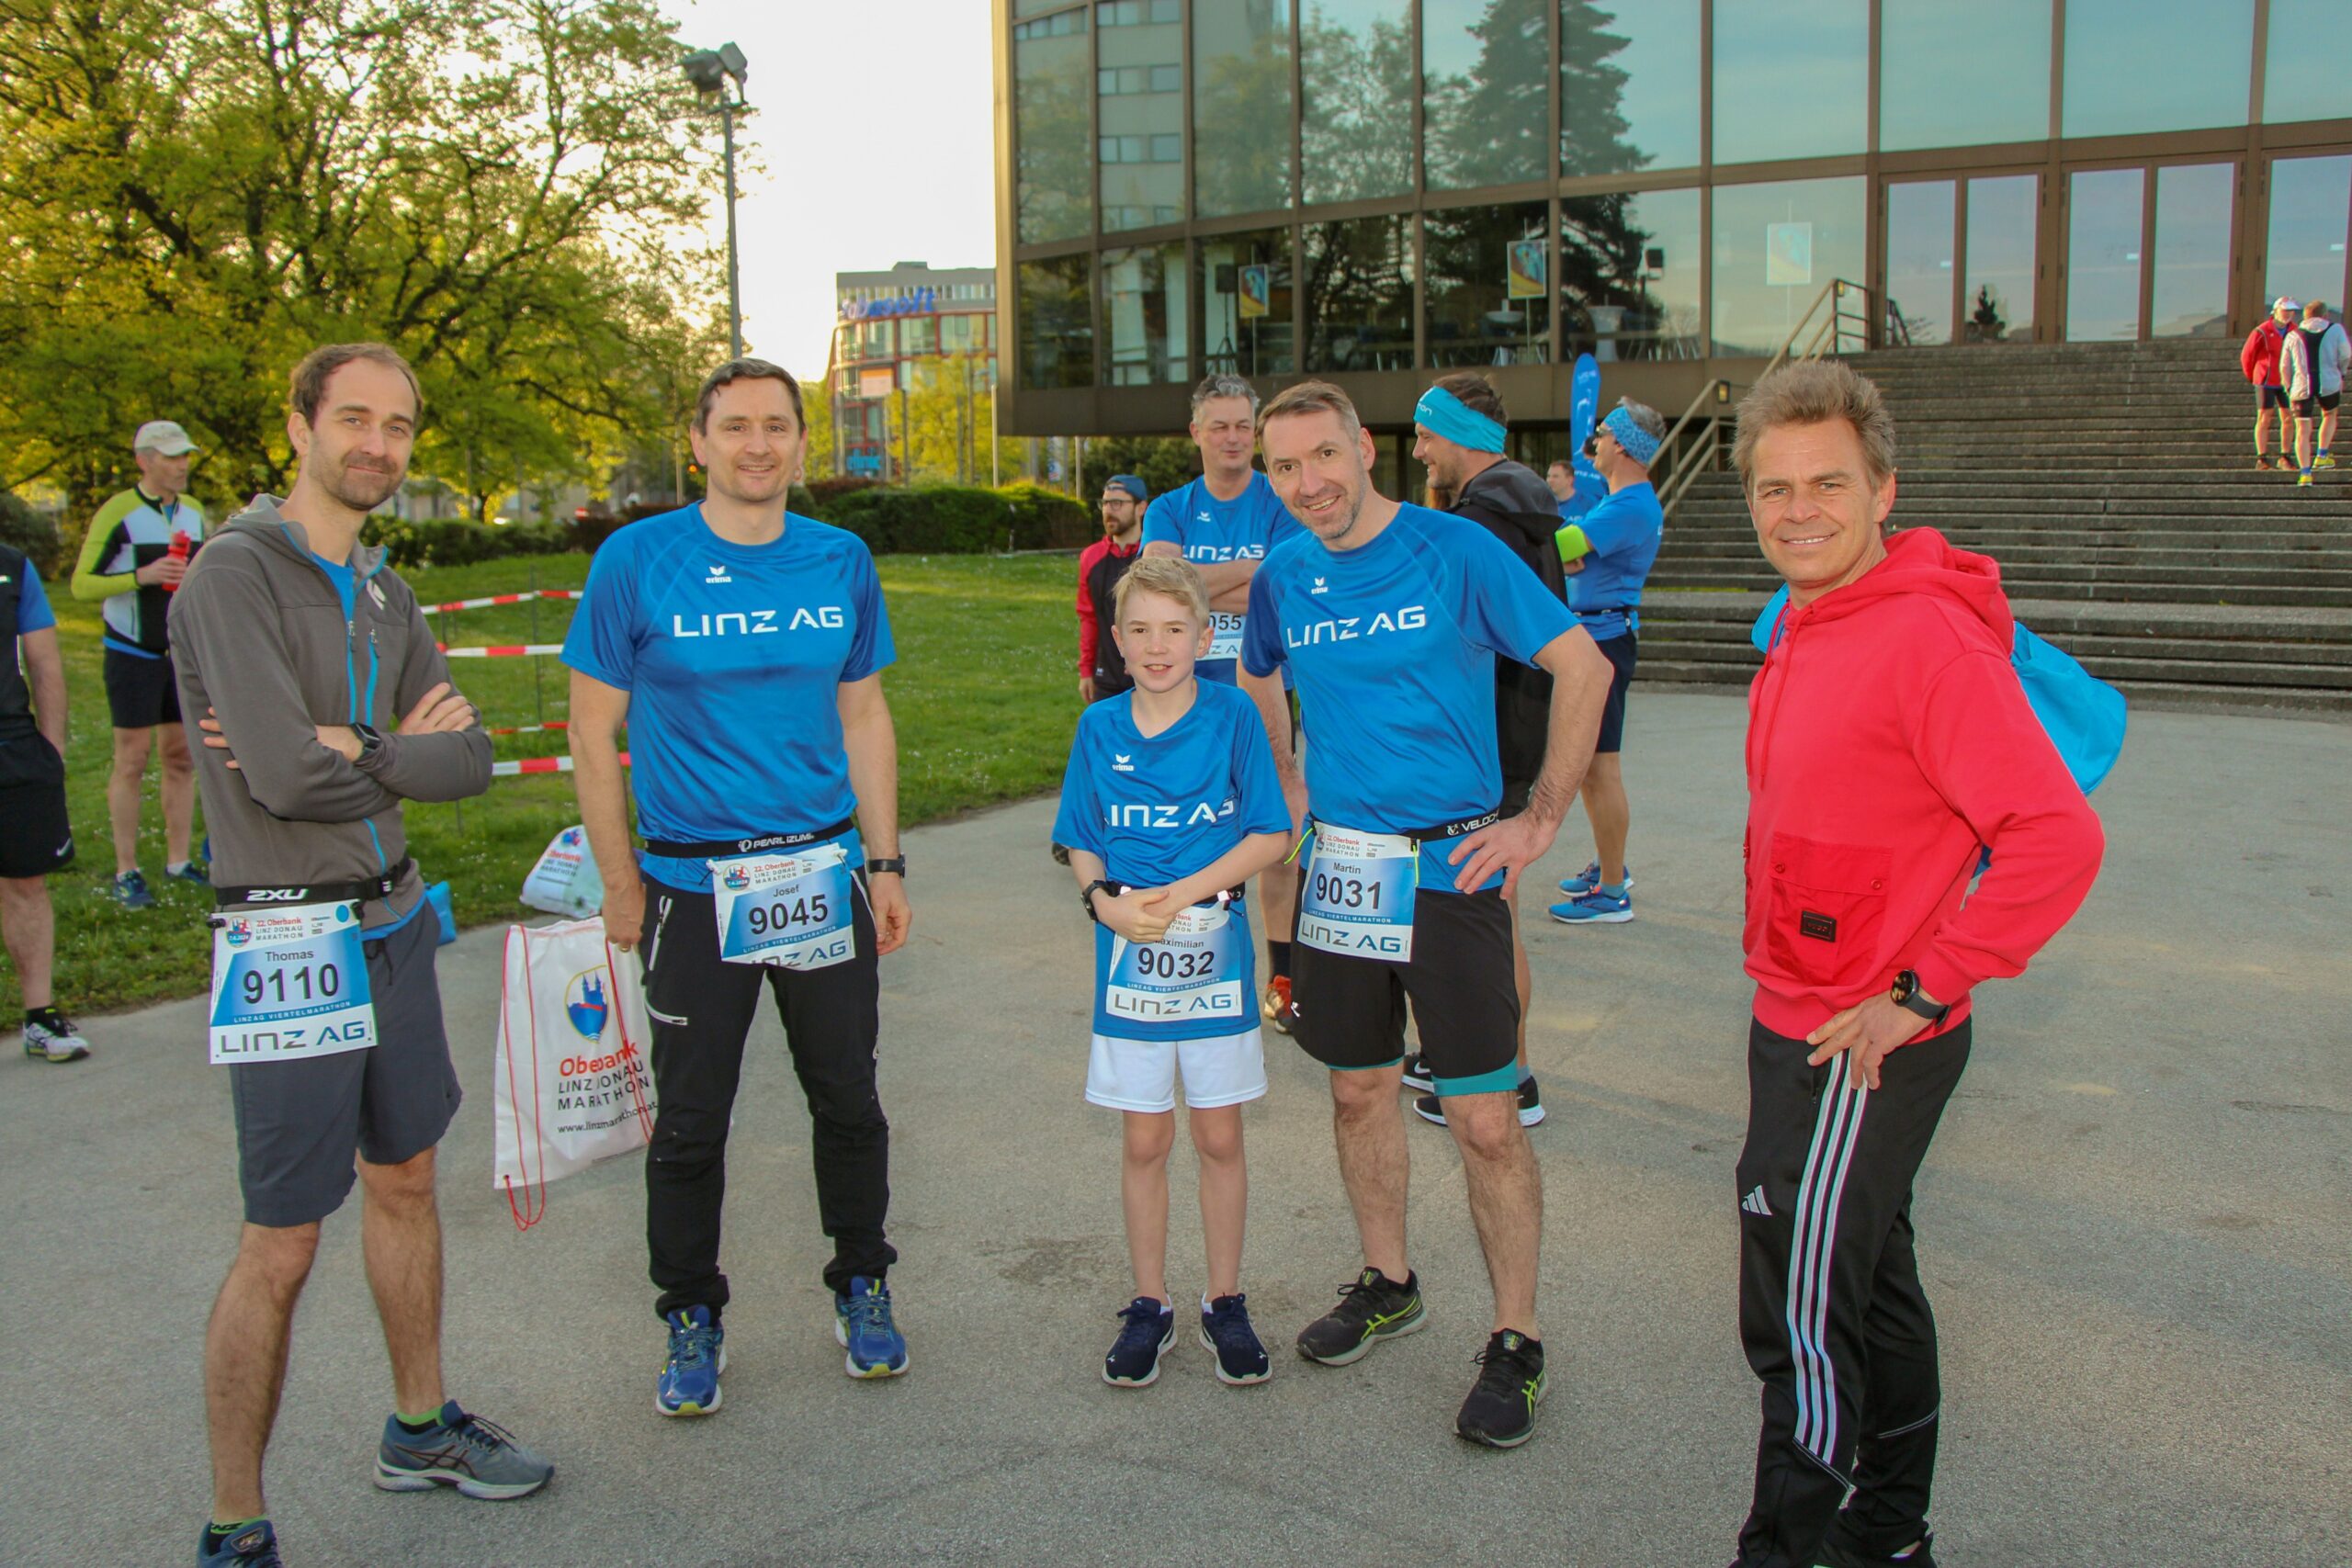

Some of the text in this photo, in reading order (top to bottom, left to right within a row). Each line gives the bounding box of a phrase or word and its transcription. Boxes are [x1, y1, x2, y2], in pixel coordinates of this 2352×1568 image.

[1311, 586, 1329, 595] erima
[673, 606, 844, 637] LINZ AG
[1208, 615, 1241, 631] 055
[1286, 605, 1426, 649] LINZ AG
[1226, 644, 1238, 654] A
[1103, 804, 1180, 828] INZ
[753, 836, 786, 849] PEARL
[1333, 836, 1360, 846] Oberbank
[1326, 848, 1360, 858] MARATHON
[1338, 844, 1360, 852] DONAU
[764, 860, 795, 871] Oberbank
[1333, 862, 1362, 874] Martin
[754, 871, 770, 879] LINZ
[773, 866, 796, 875] DONAU
[754, 872, 797, 885] MARATHON
[246, 888, 309, 902] 2XU
[773, 884, 799, 897] Josef
[1316, 873, 1381, 909] 9031
[748, 894, 828, 935] 9045
[1176, 913, 1192, 921] bank
[1327, 912, 1392, 924] VIERTELMARATHON
[266, 917, 301, 927] Oberbank
[274, 925, 303, 933] DONAU
[772, 925, 837, 946] VIERTELMARATHON
[1170, 925, 1192, 933] THON
[255, 932, 304, 941] MARATHON
[1302, 919, 1350, 947] LINZ
[1356, 934, 1401, 953] AG
[266, 951, 314, 963] Thomas
[808, 941, 847, 964] AG
[1137, 947, 1215, 979] 9032
[243, 963, 339, 1005] 9110
[1155, 977, 1221, 992] VIERTELMARATHON
[268, 1001, 351, 1020] VIERTELMARATHON
[1114, 994, 1232, 1015] LINZ AG
[220, 1021, 366, 1054] LINZ AG
[558, 1078, 593, 1094] LINZ
